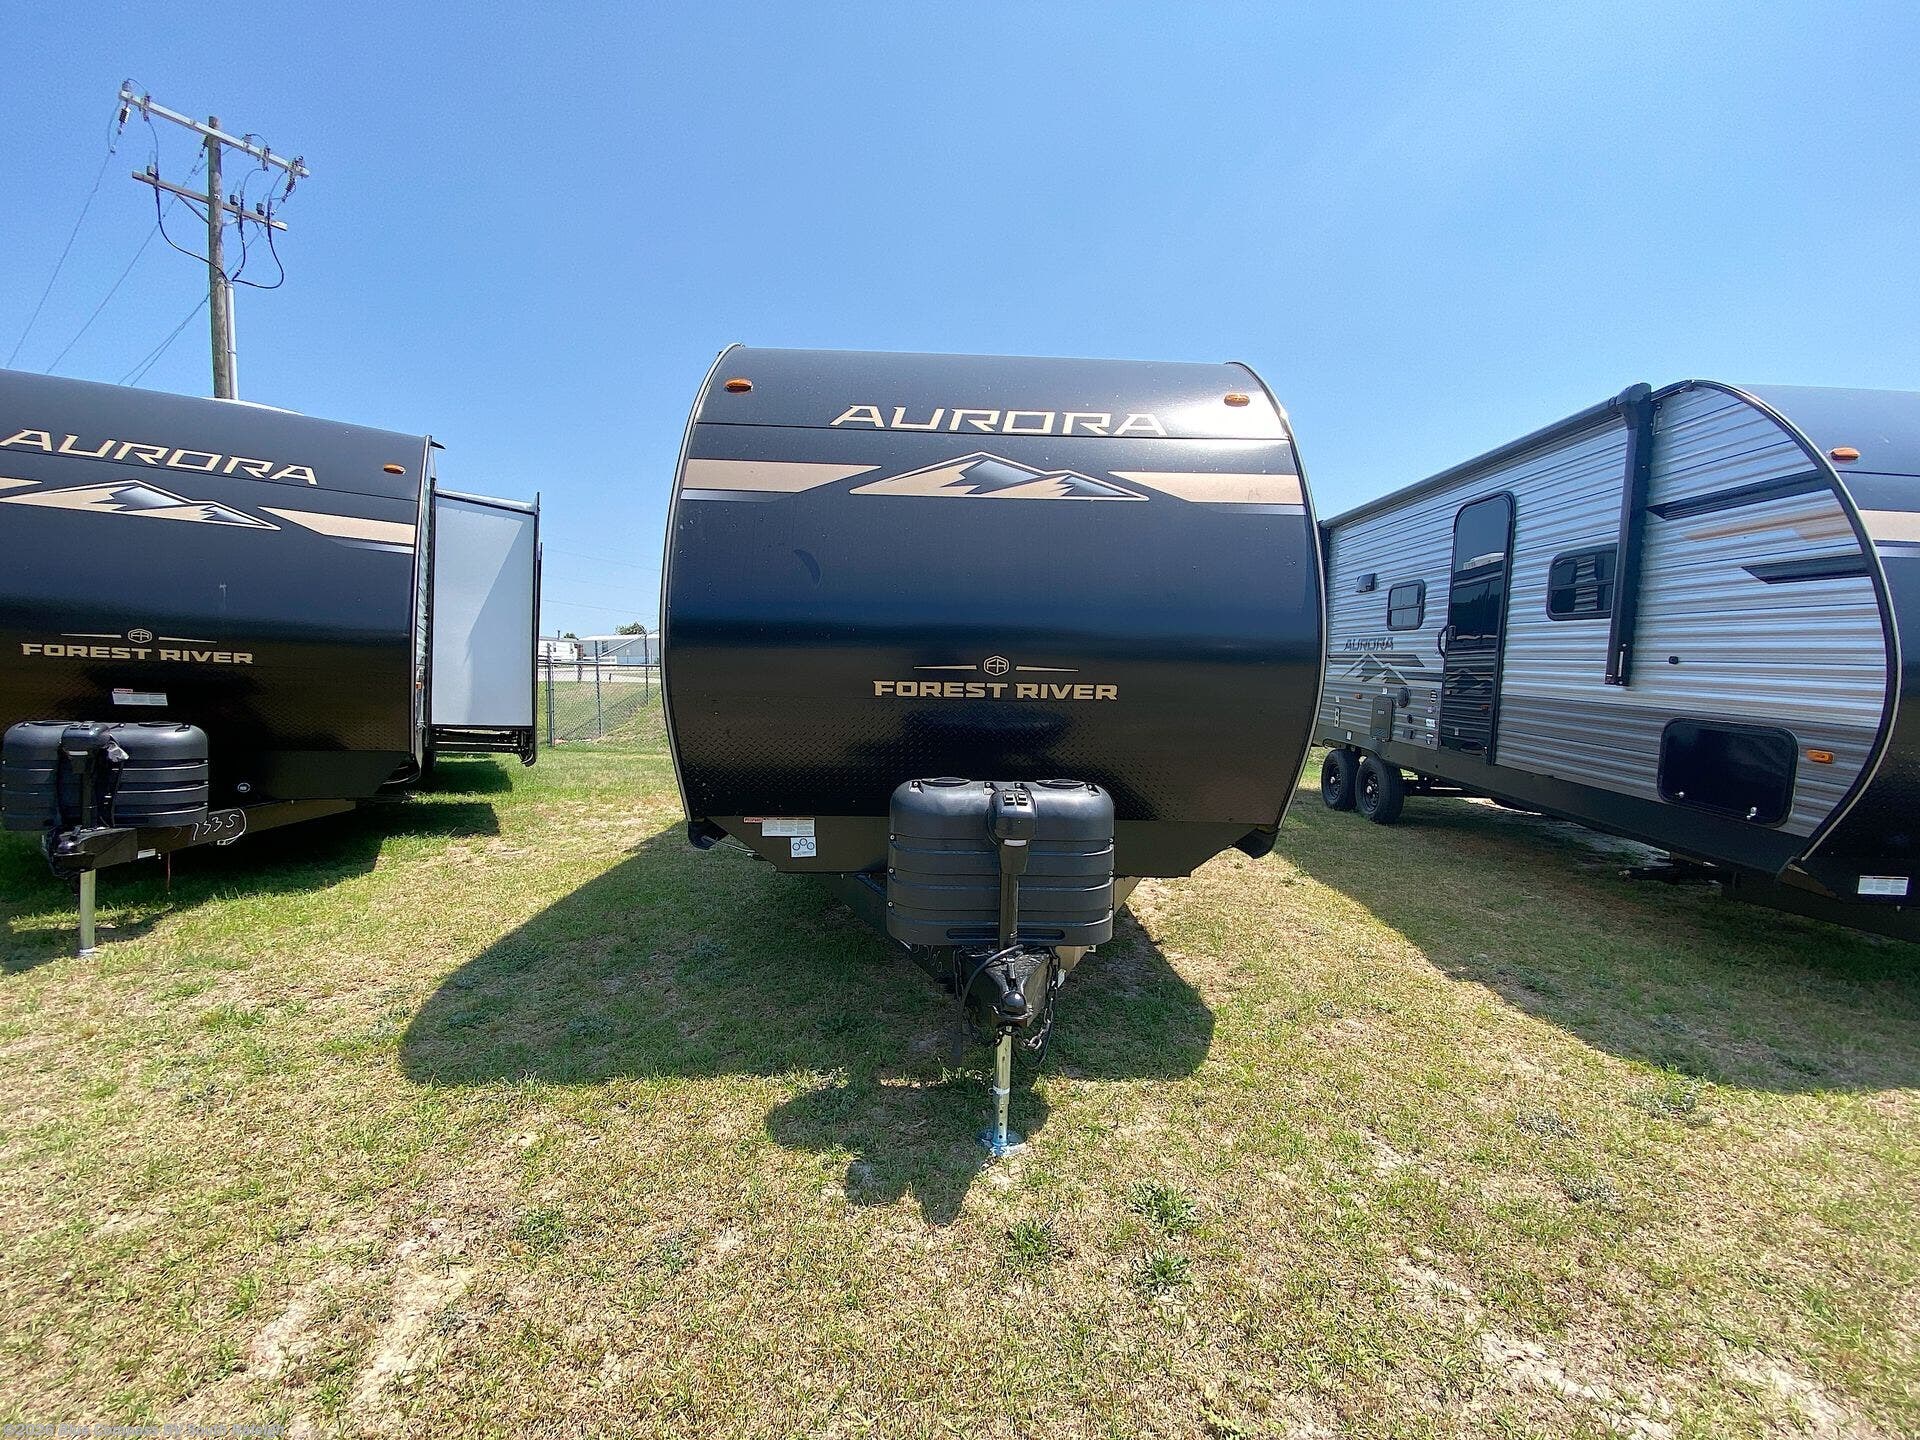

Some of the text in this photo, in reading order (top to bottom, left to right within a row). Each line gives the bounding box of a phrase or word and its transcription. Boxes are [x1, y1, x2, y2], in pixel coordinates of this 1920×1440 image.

[830, 404, 1168, 436] AURORA
[0, 428, 318, 486] AURORA
[20, 643, 254, 665] FOREST RIVER
[1343, 636, 1394, 652] AURORA
[872, 680, 1118, 701] FOREST RIVER
